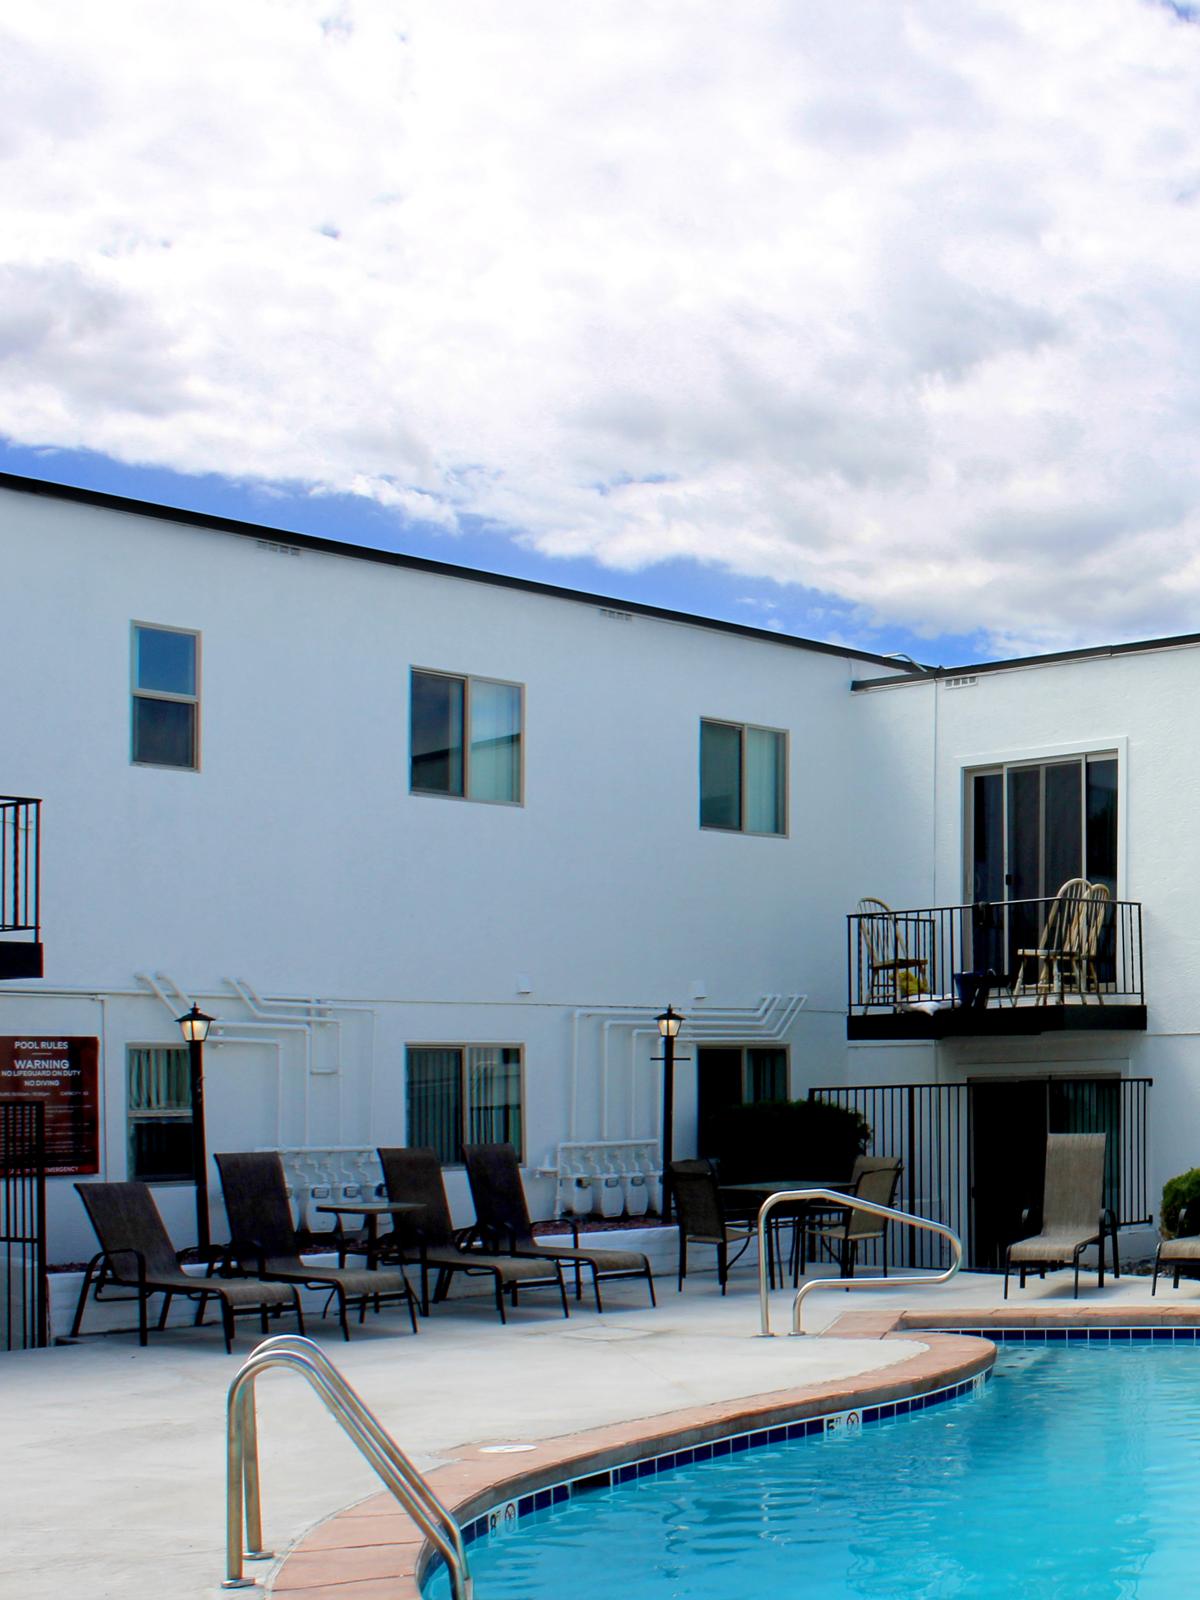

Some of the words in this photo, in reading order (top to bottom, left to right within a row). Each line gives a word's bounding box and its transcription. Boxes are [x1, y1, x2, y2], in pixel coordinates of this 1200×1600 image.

[14, 1041, 39, 1050] POOL
[41, 1041, 69, 1050] RULES
[14, 1059, 70, 1070] WARNING
